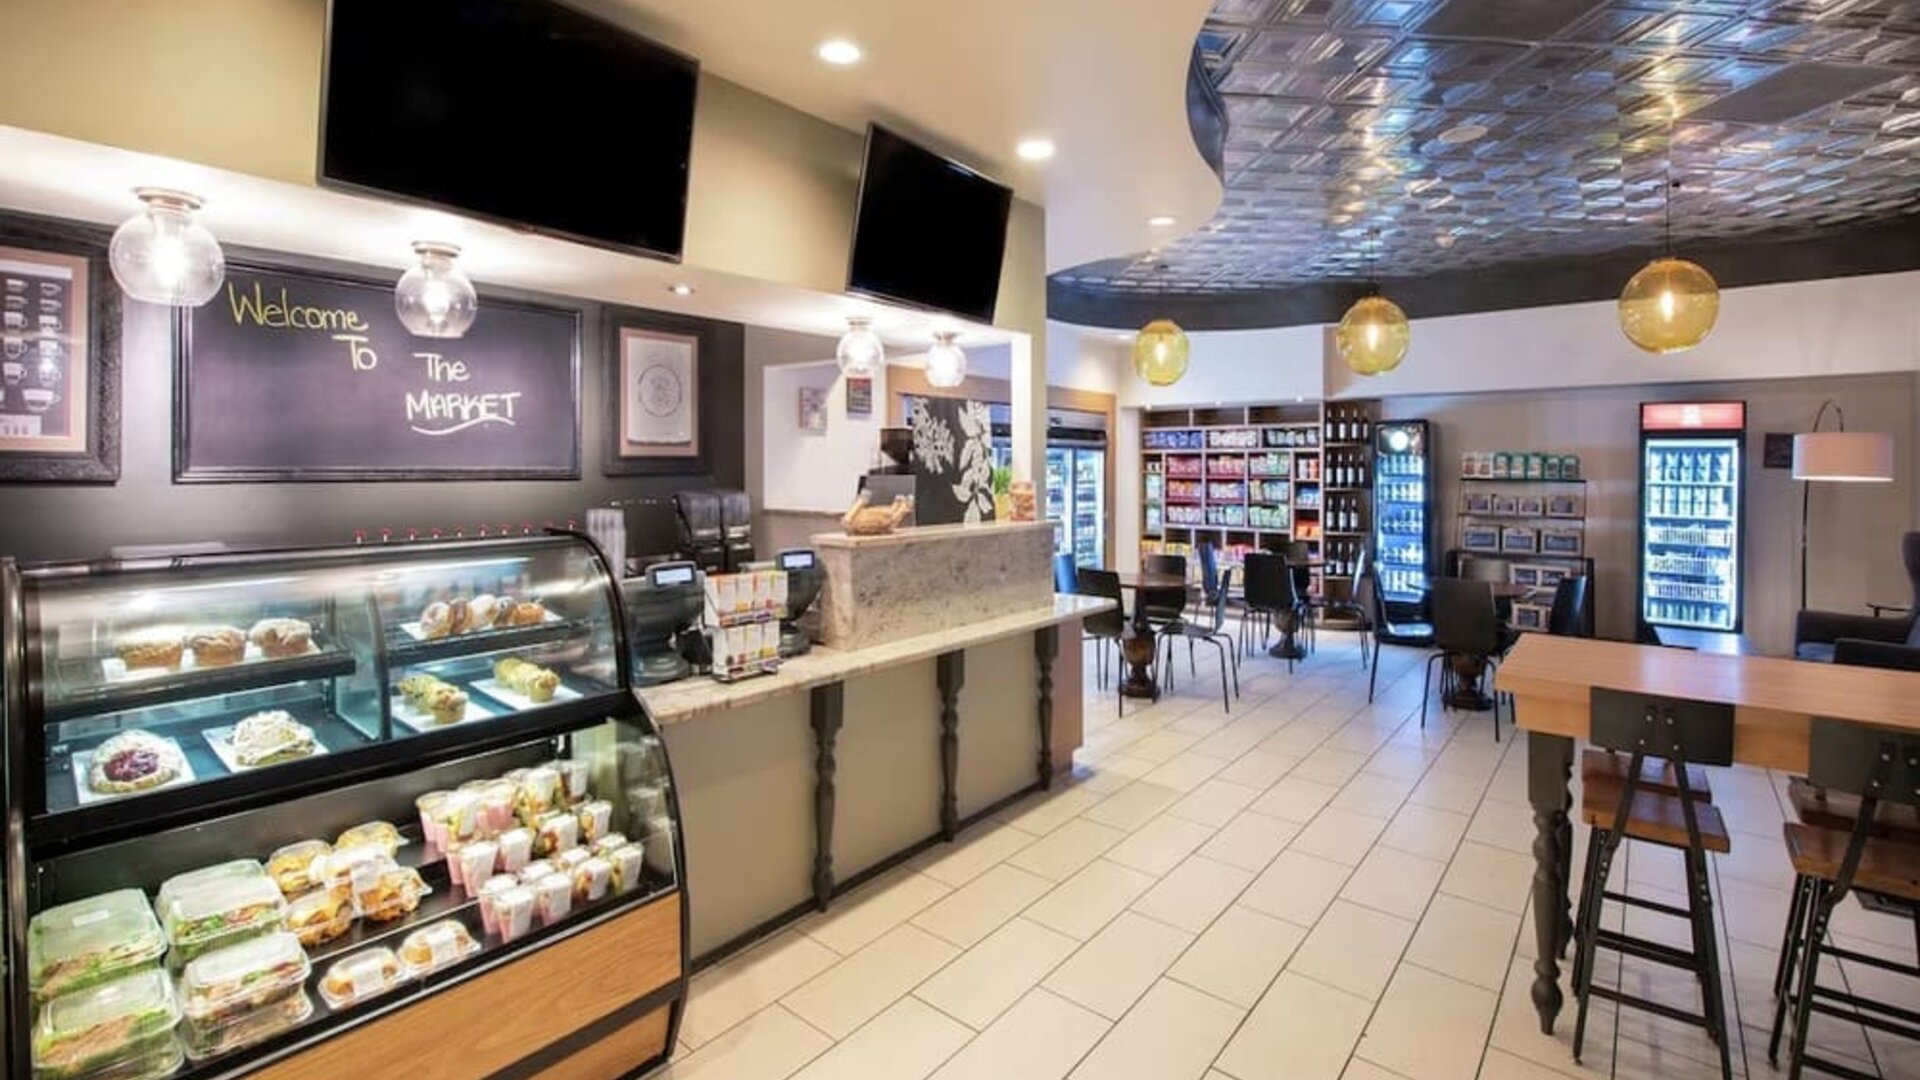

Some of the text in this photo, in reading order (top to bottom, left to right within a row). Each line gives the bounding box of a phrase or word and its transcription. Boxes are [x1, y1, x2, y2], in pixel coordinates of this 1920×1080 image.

[228, 282, 369, 331] Welcome
[332, 334, 378, 370] To
[414, 353, 471, 382] The
[405, 390, 522, 420] MARKET
